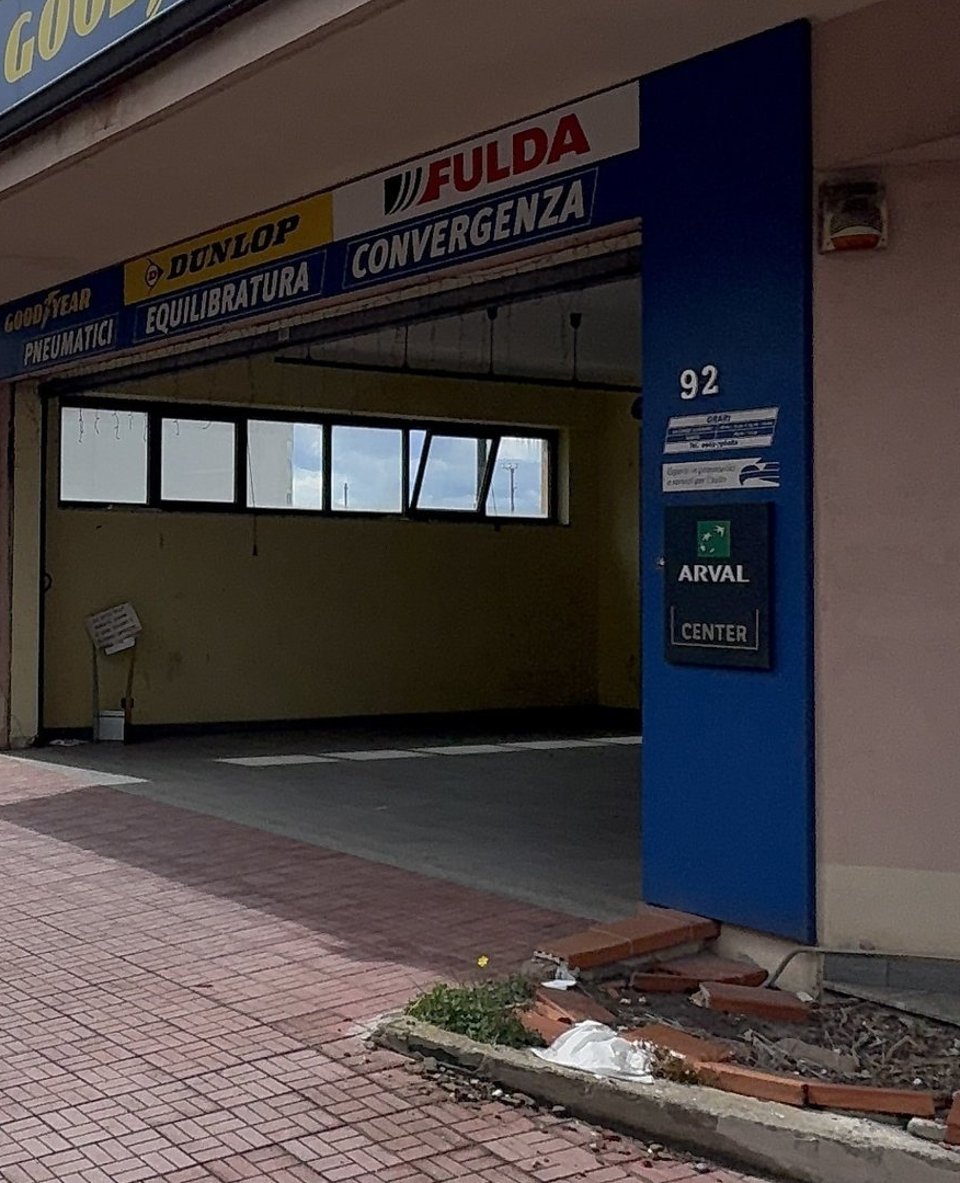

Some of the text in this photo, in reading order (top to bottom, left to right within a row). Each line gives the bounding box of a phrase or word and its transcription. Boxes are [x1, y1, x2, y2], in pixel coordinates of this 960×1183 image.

[416, 113, 591, 206] FULDA
[166, 214, 300, 280] DUNLOP
[352, 179, 585, 279] CONVERGENZA
[4, 287, 92, 334] GOODYEAR
[145, 261, 309, 337] EQUILIBRATURA
[23, 319, 114, 366] PNEUMATICI
[680, 364, 719, 400] 92
[678, 564, 751, 583] ARVAL
[681, 622, 747, 643] CENTER
